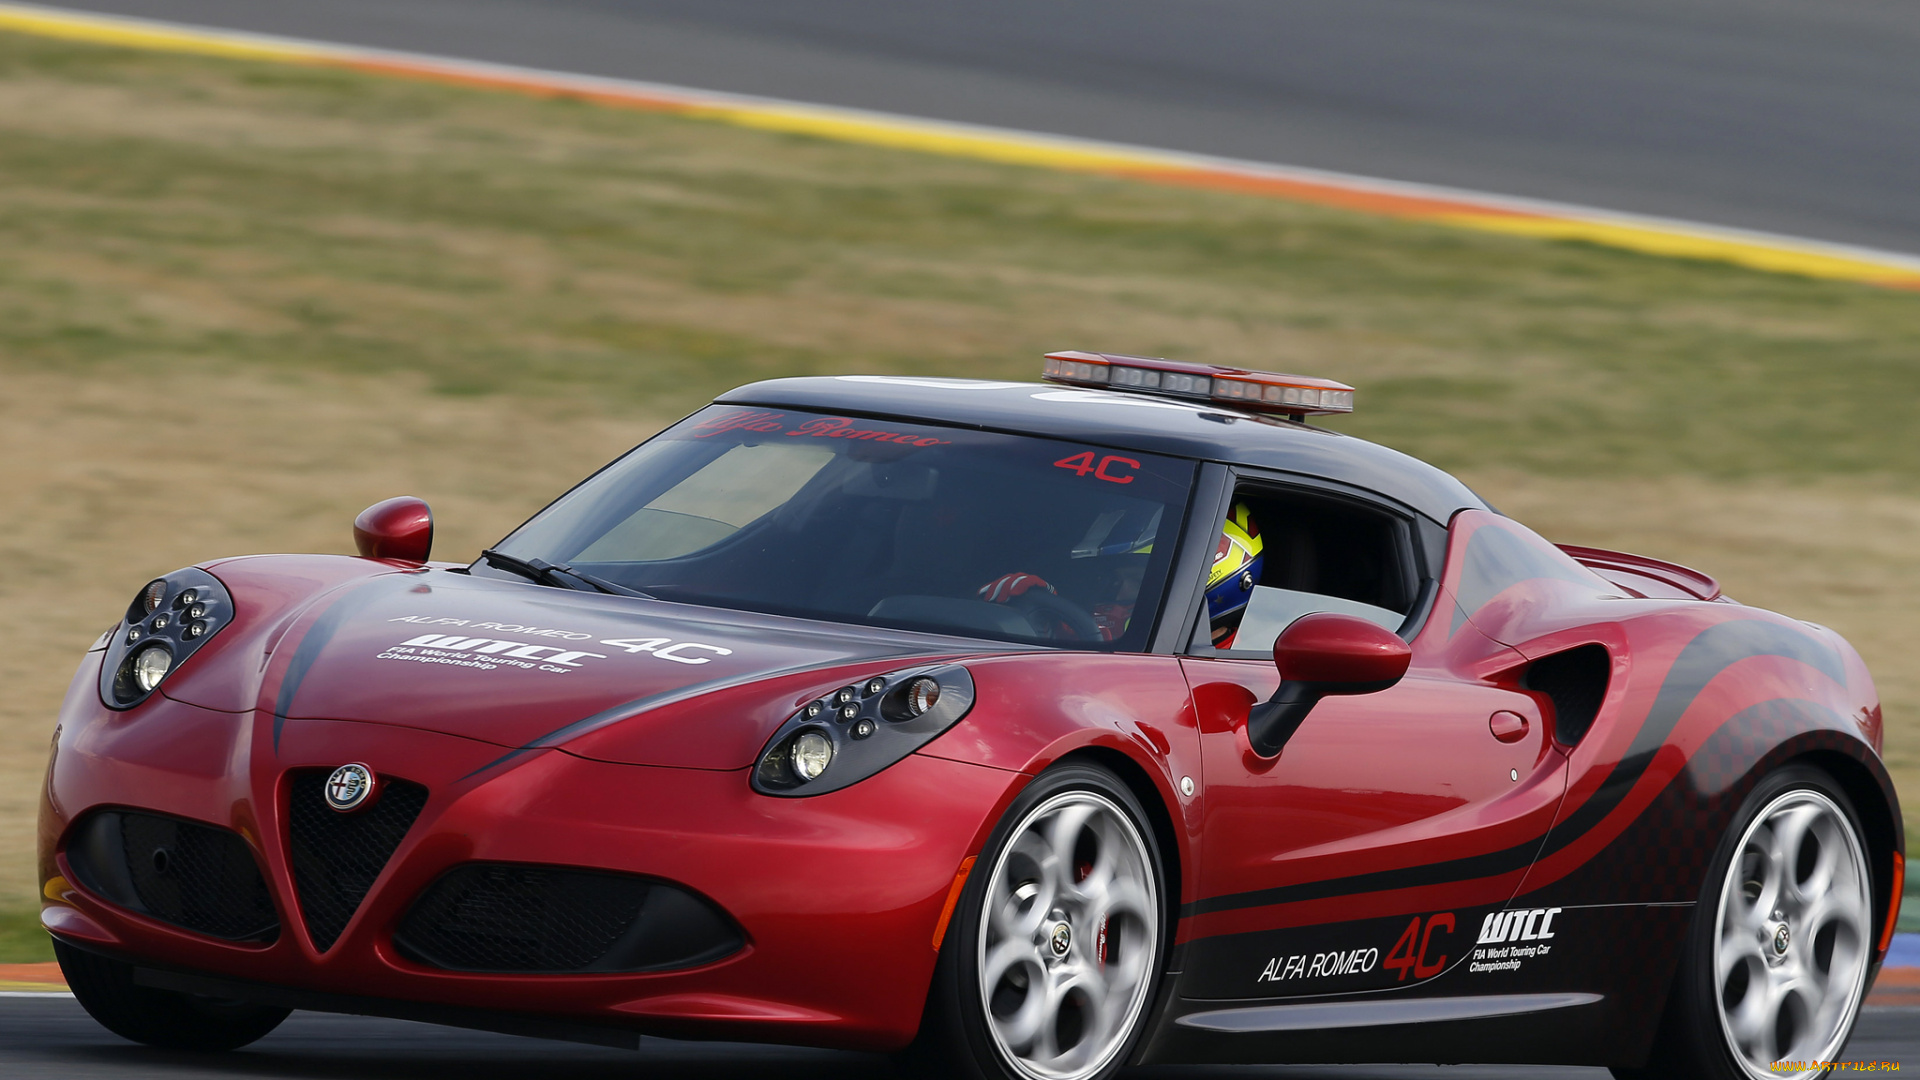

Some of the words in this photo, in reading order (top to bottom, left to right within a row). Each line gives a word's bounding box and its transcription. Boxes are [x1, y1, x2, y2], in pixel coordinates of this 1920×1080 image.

[693, 411, 785, 438] Alfa
[785, 416, 952, 447] Romeo
[1053, 451, 1141, 484] 4C
[388, 615, 471, 627] ALFA
[470, 621, 592, 640] ROMEO
[599, 637, 733, 665] 4C
[400, 633, 607, 667] WTCC
[376, 652, 498, 671] Championship
[386, 646, 416, 654] FIA
[421, 648, 472, 660] World
[475, 653, 536, 669] Touring
[538, 664, 572, 674] Car
[1476, 907, 1562, 944] WTCC
[1257, 955, 1307, 983] ALFA
[1307, 947, 1379, 978] ROMEO
[1383, 912, 1456, 981] 4C
[1473, 949, 1486, 960] FIA
[1487, 947, 1510, 959] World
[1510, 945, 1537, 958] Touring
[1537, 944, 1551, 955] Car
[1469, 959, 1522, 973] Championship
